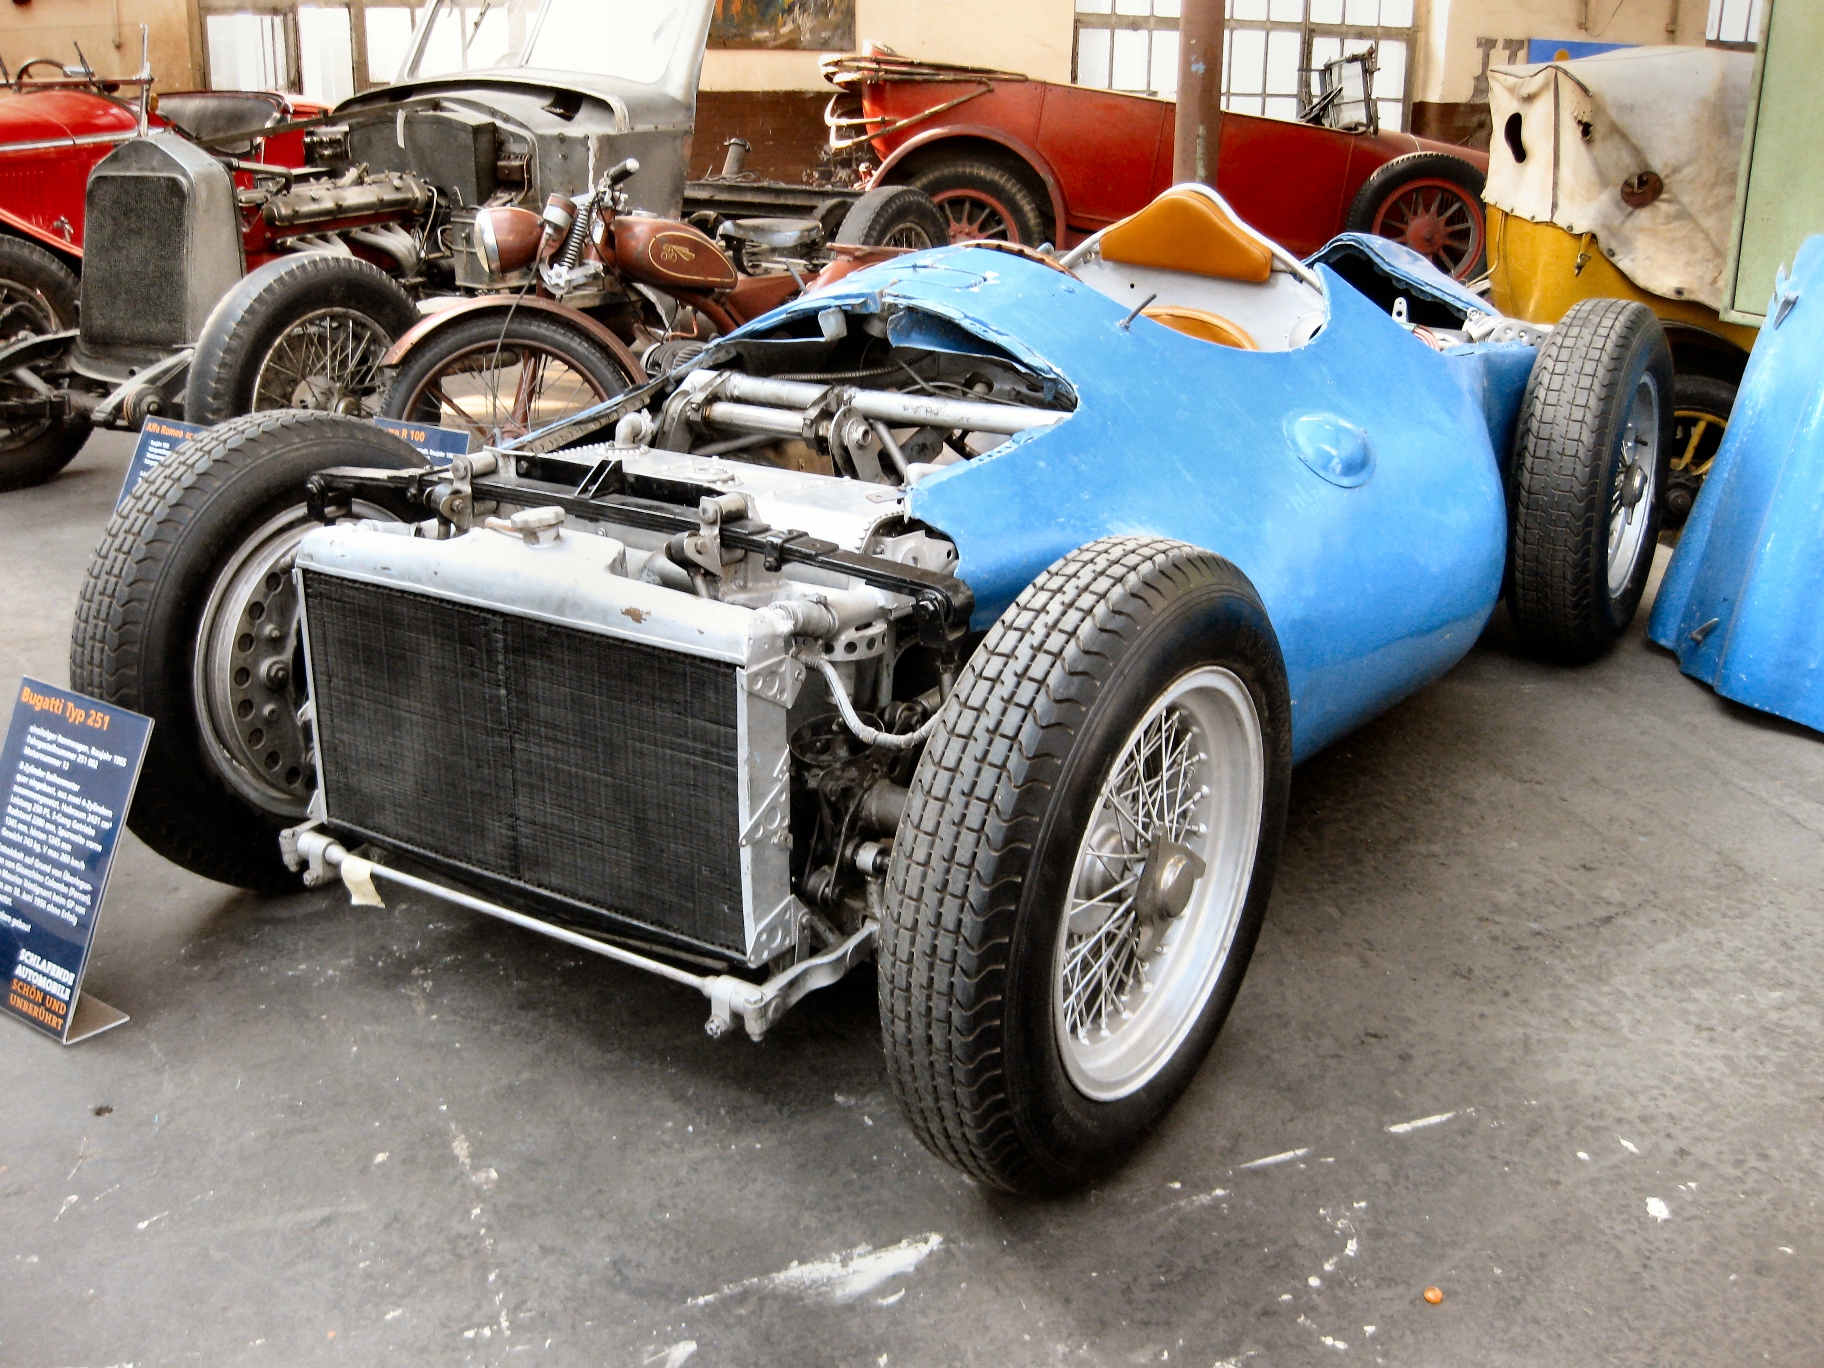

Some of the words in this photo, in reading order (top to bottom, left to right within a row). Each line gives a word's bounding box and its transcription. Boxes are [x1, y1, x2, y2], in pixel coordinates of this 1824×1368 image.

[145, 422, 160, 434] Alfa
[161, 425, 183, 438] Romeo
[402, 428, 408, 439] R
[410, 429, 426, 442] 100
[21, 687, 64, 713] Bugatti
[65, 702, 86, 725] Typ
[87, 709, 111, 731] 251
[15, 964, 71, 1001] AUTOMOBILE
[19, 949, 76, 986] SCHLAFENDE
[9, 993, 64, 1031] UNBERÜHRT
[11, 978, 43, 1004] SCHÖN
[45, 994, 67, 1016] UND
